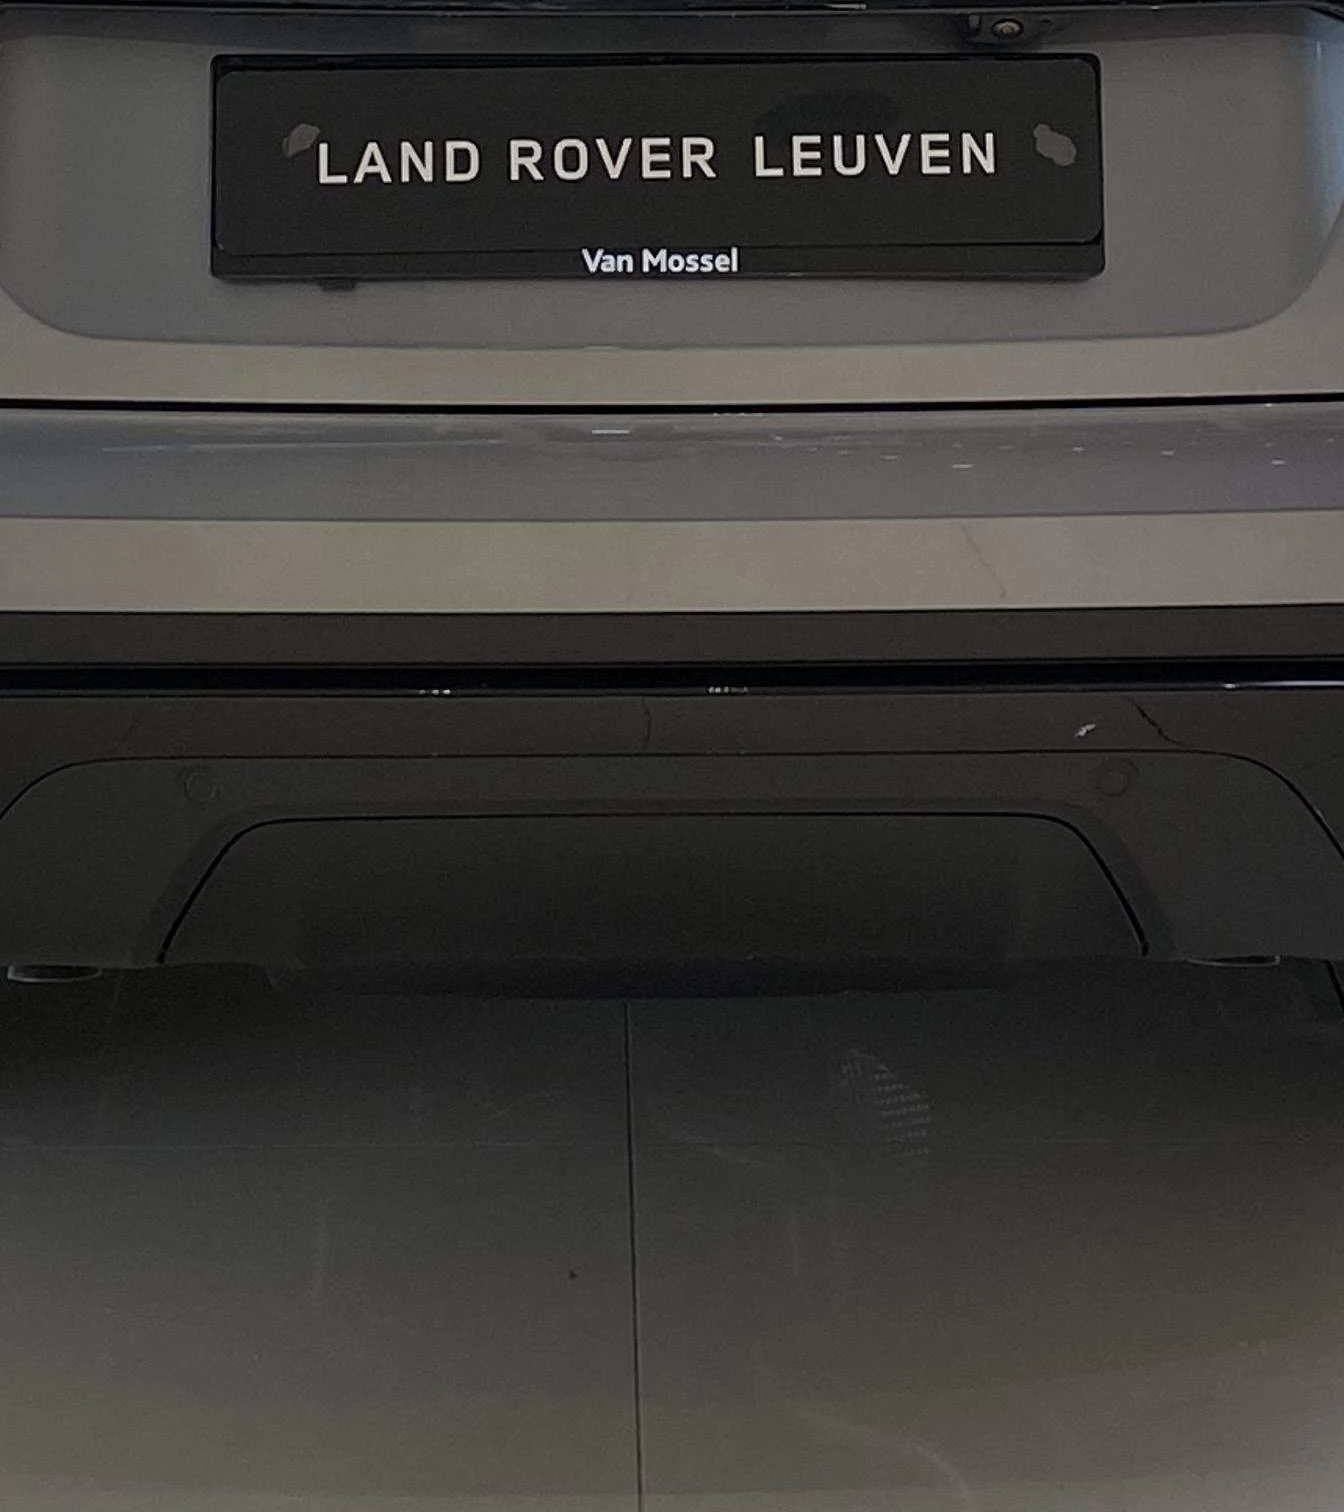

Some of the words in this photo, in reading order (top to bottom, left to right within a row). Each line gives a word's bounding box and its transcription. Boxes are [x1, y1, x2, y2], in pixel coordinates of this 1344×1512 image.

[317, 140, 480, 184] LAND
[508, 137, 718, 181] ROVER
[753, 131, 996, 177] LEUVEN
[581, 247, 634, 273] Van
[641, 246, 739, 273] Mossel
